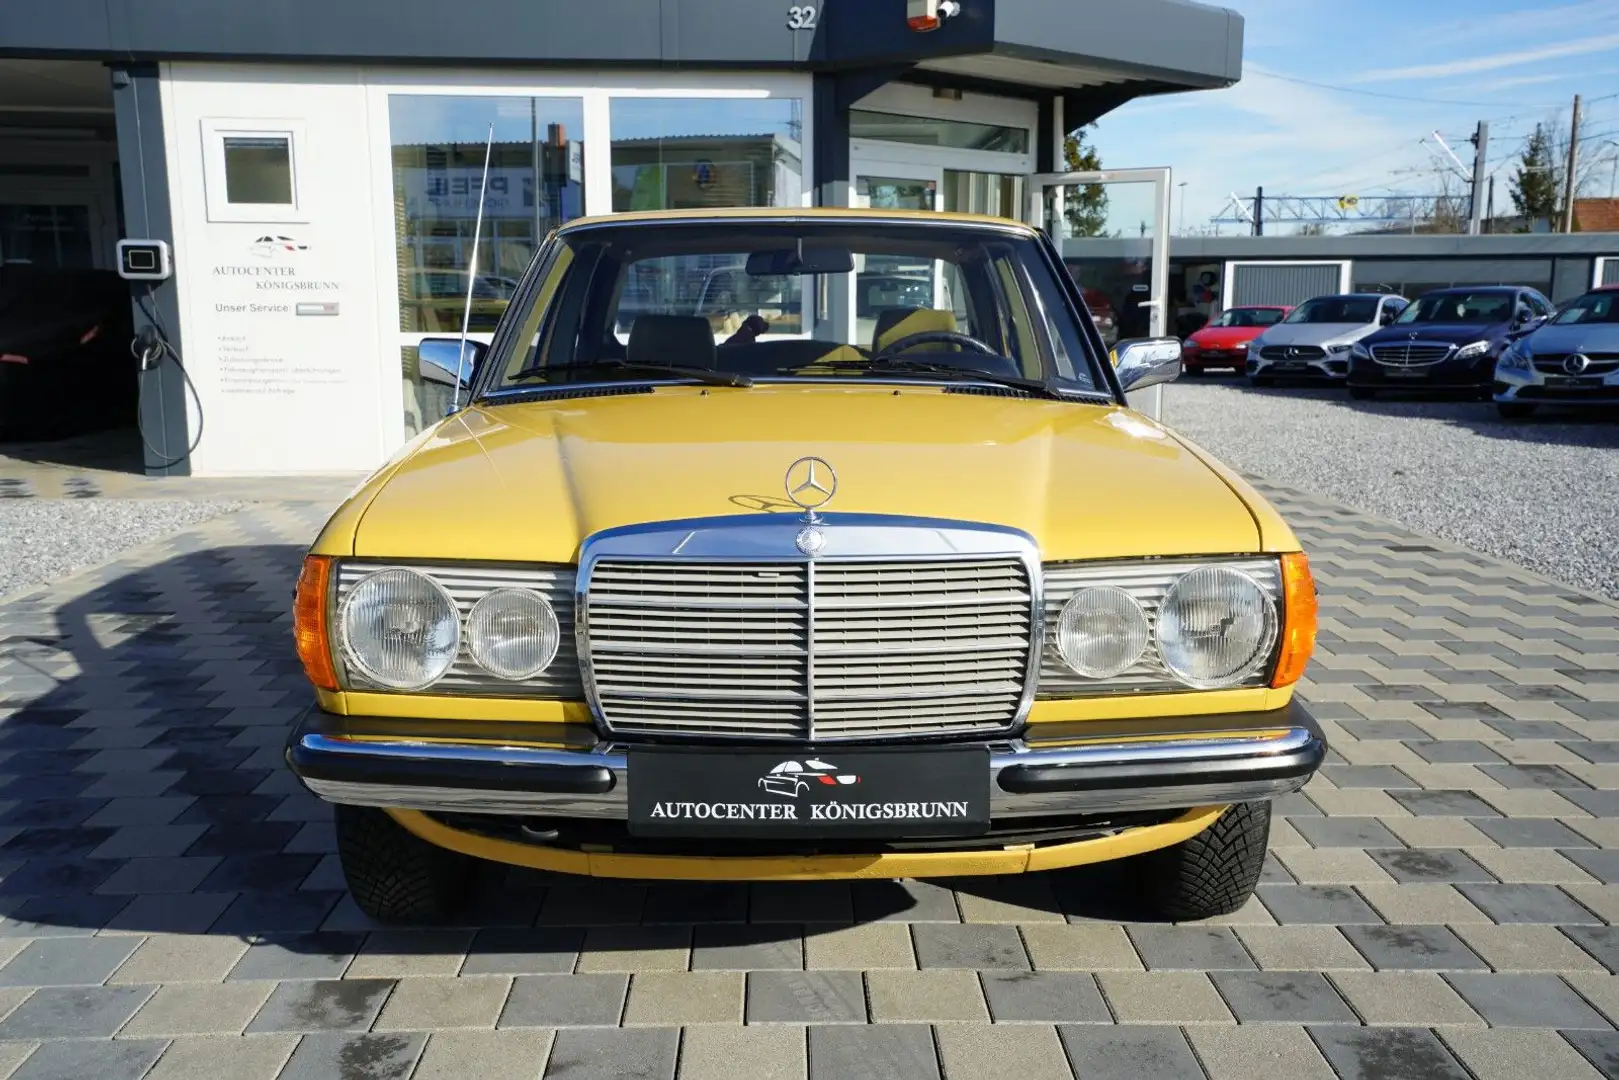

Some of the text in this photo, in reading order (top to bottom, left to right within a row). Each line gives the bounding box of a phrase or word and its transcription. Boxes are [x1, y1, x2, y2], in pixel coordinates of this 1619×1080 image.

[788, 6, 816, 29] 32
[212, 266, 296, 276] AUTOCENTER
[255, 279, 340, 290] KÖNIGSBRUNN
[215, 303, 246, 313] Unser
[650, 800, 969, 820] AUTOCENTER KÖNIGSBRUNN
